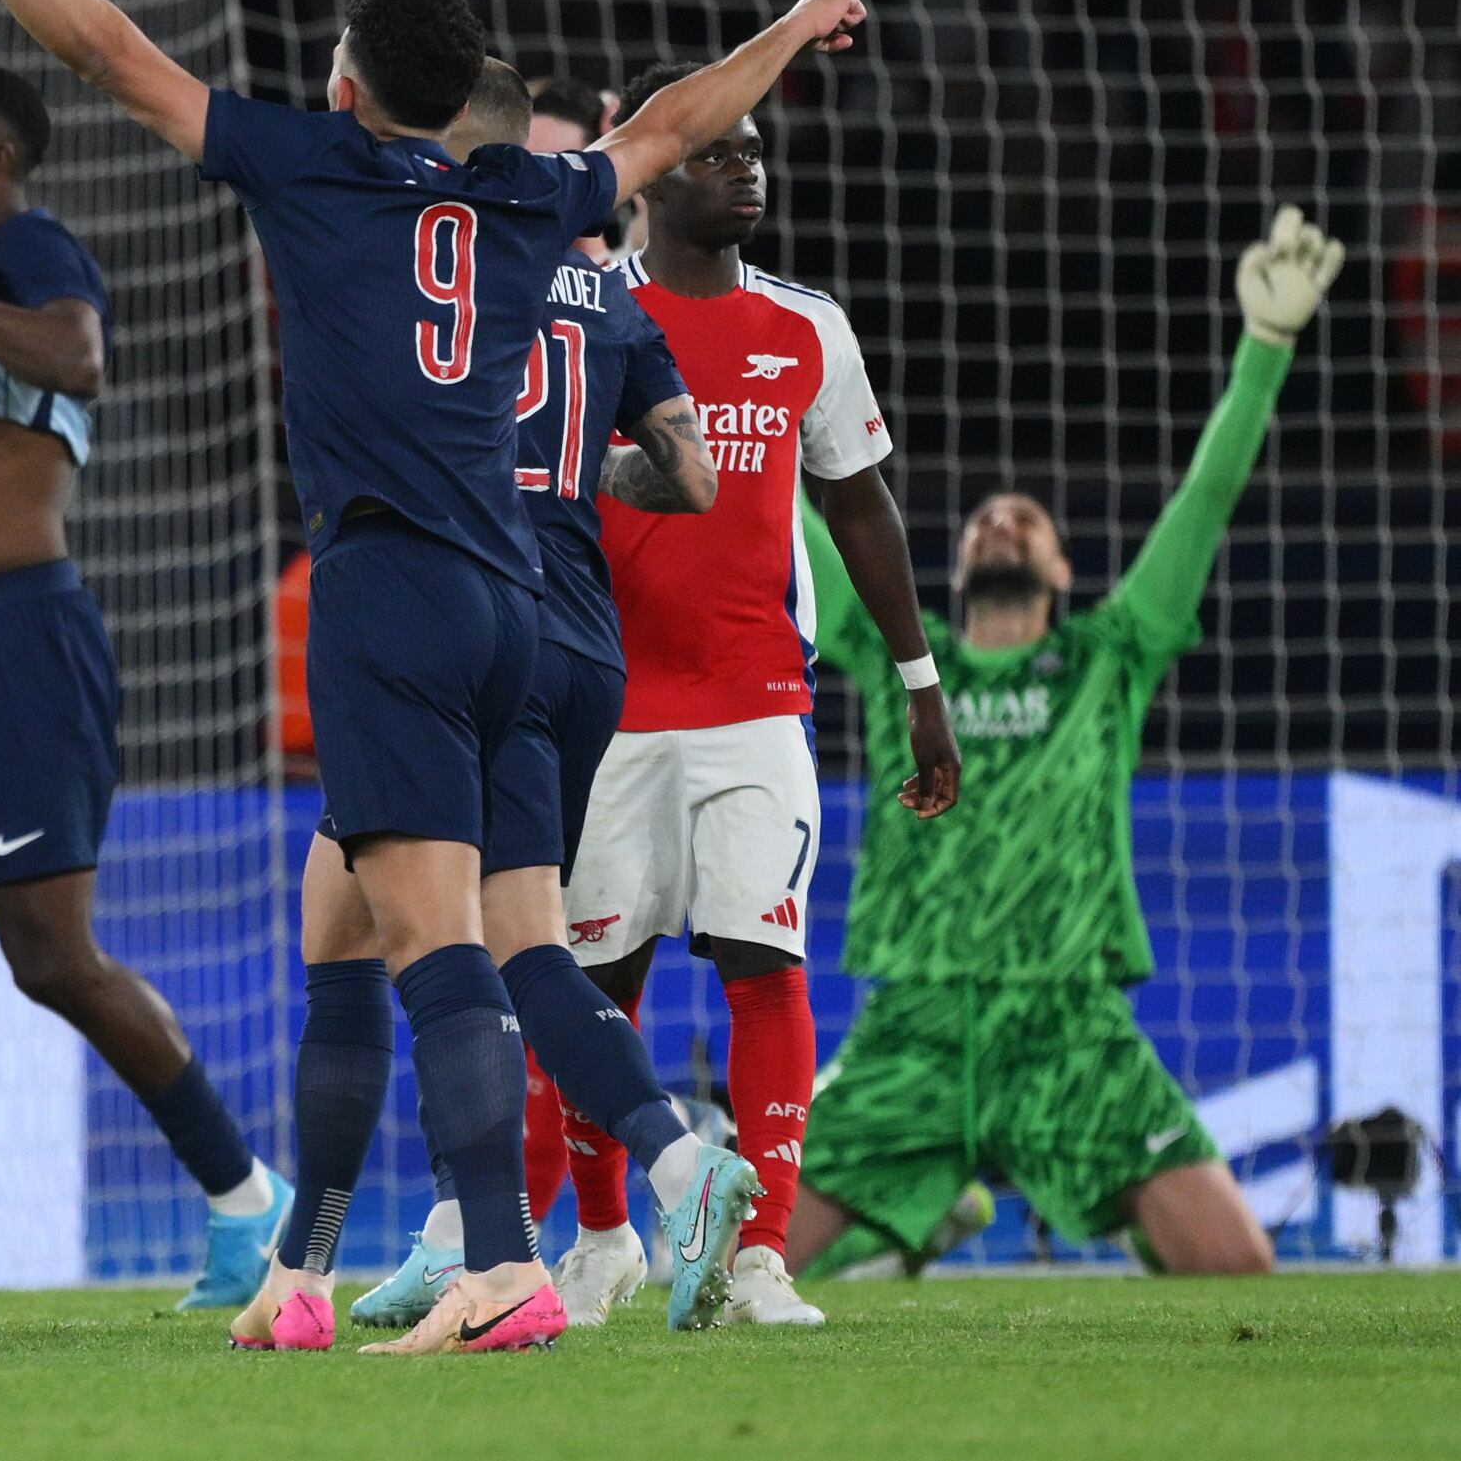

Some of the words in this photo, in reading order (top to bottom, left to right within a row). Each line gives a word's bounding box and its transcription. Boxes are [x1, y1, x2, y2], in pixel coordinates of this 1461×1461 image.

[415, 200, 478, 386] 9
[546, 265, 607, 314] NDEZ
[786, 819, 811, 892] 7
[765, 1101, 807, 1122] AFC
